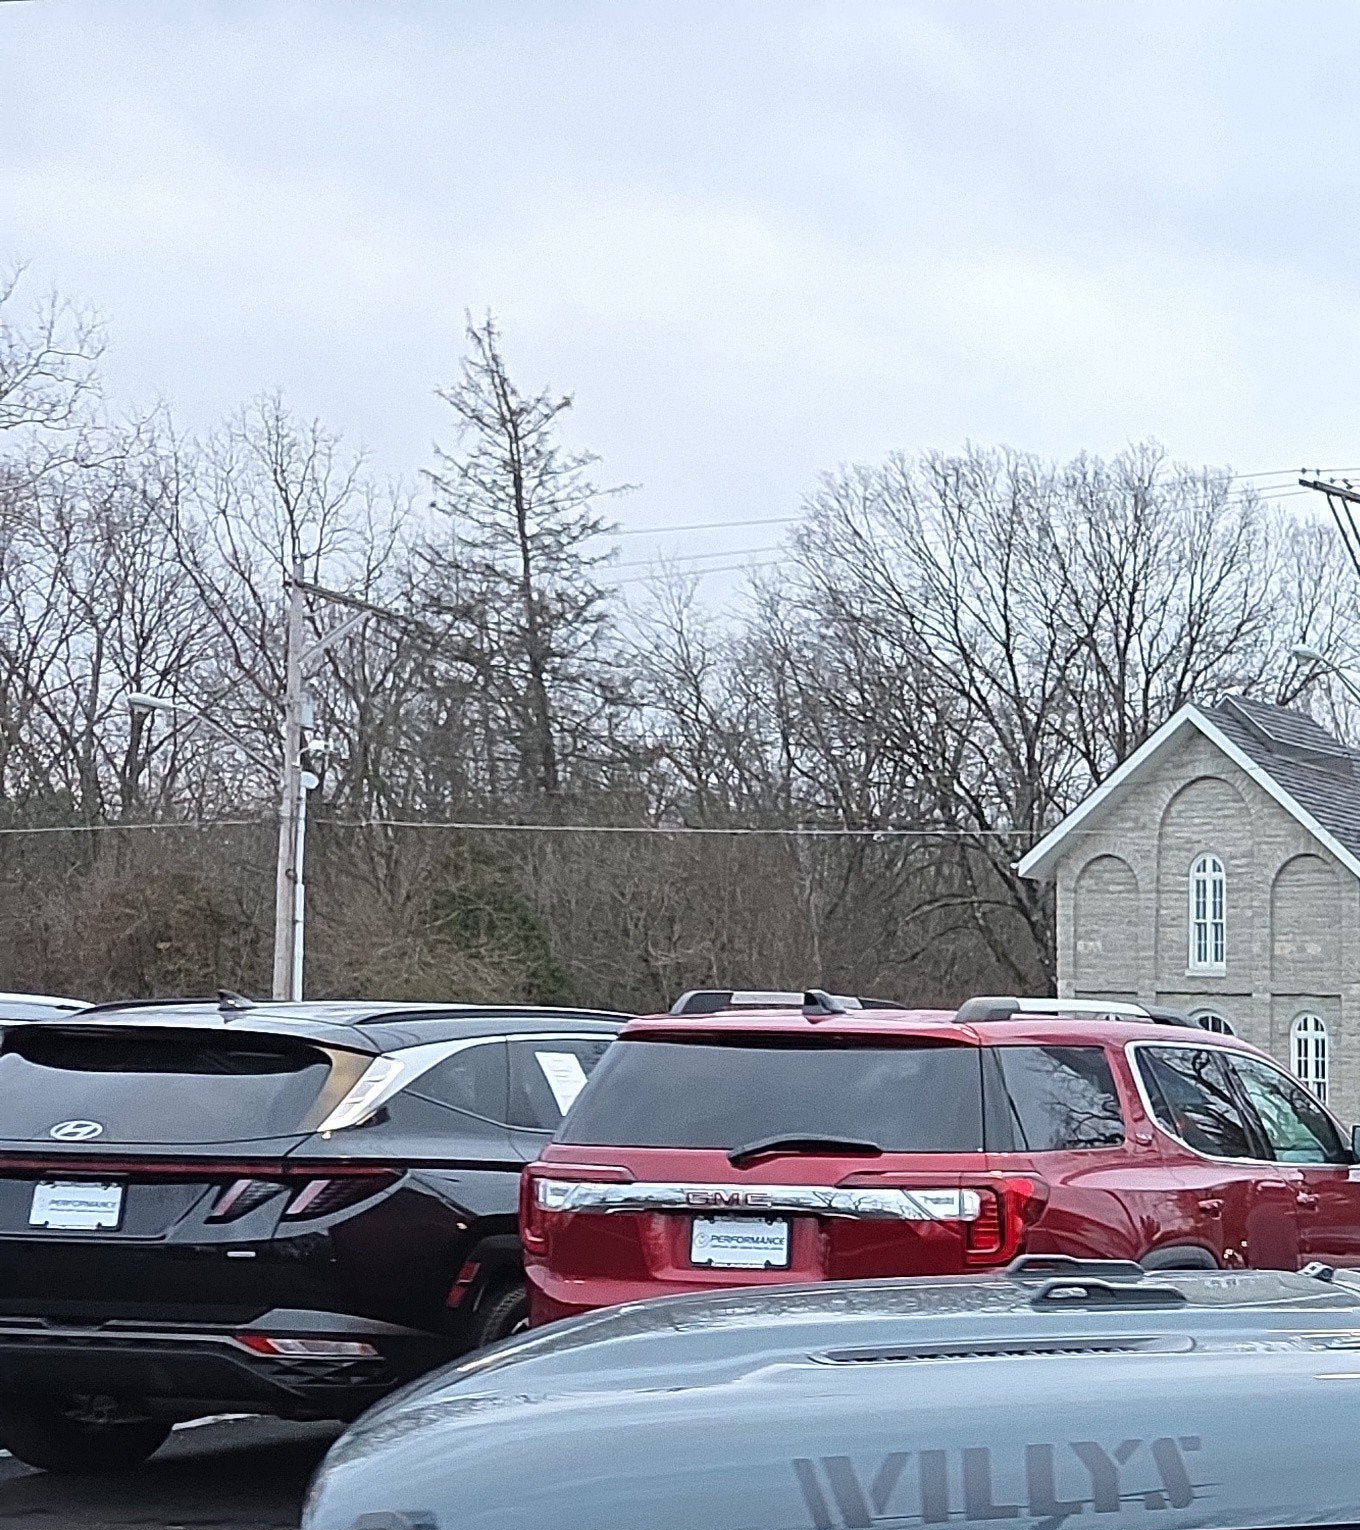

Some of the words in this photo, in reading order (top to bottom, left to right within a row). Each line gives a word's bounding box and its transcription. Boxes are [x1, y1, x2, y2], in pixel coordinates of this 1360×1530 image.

[686, 1191, 772, 1206] GMC
[711, 1234, 786, 1246] PERFORMANCE
[792, 1436, 1200, 1530] WILLYS
